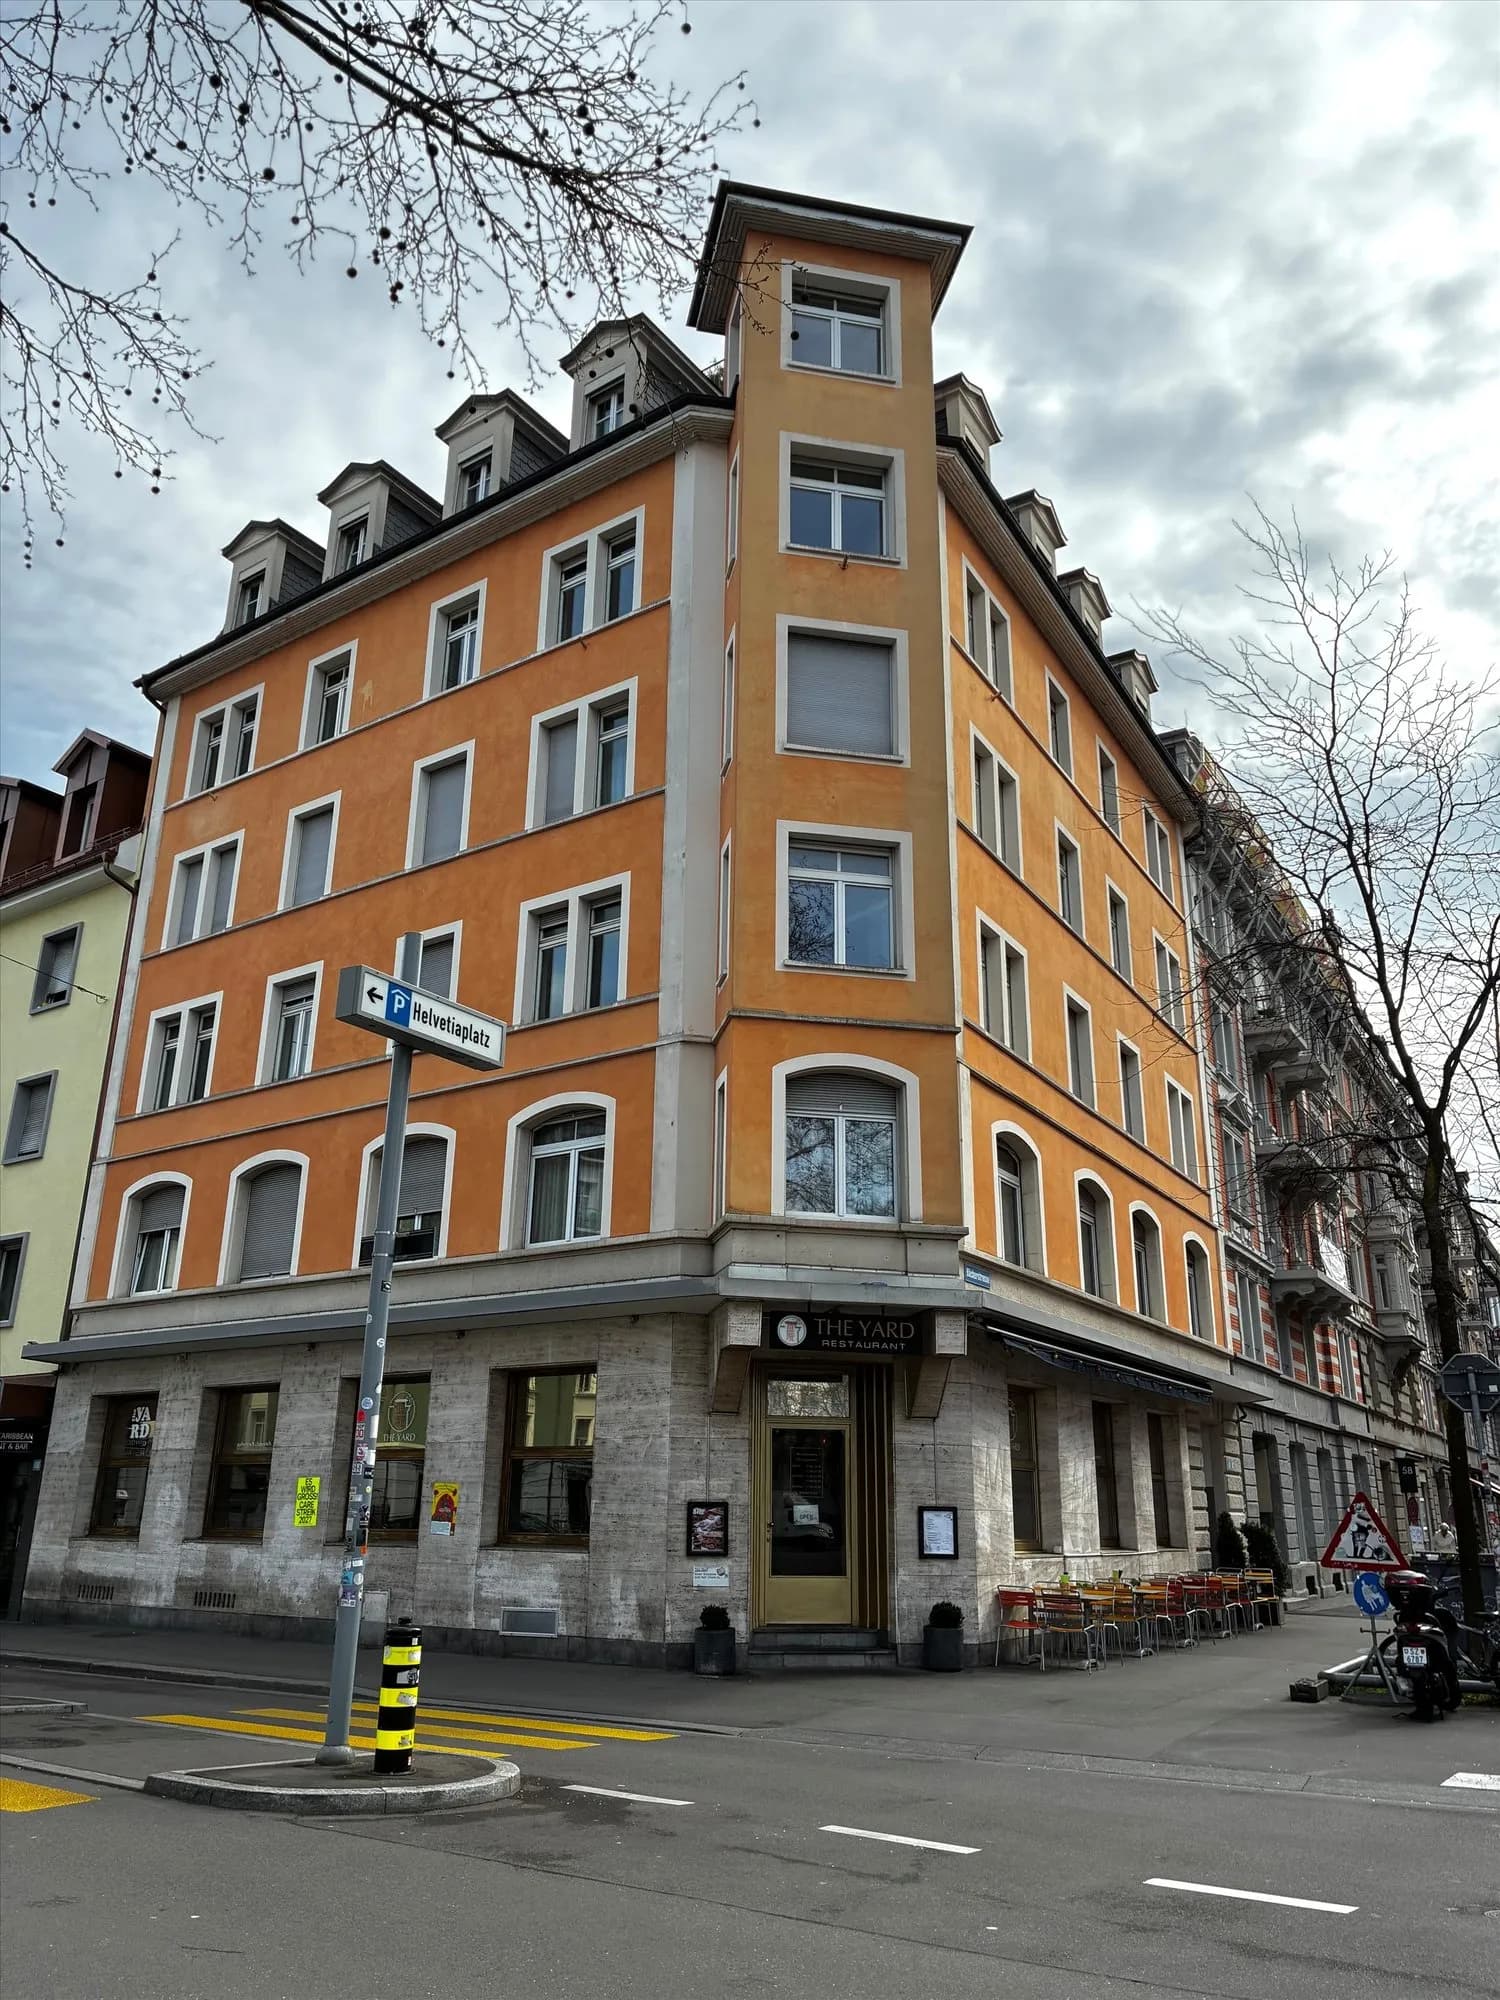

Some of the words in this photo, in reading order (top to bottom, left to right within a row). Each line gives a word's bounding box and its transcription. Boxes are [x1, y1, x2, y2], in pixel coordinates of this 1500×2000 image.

[393, 994, 405, 1013] P
[413, 1001, 490, 1048] Helvetiaplatz
[814, 1318, 854, 1337] THE
[858, 1321, 915, 1339] YARD
[821, 1339, 907, 1351] RESTAURANT
[299, 1501, 315, 1509] CARE
